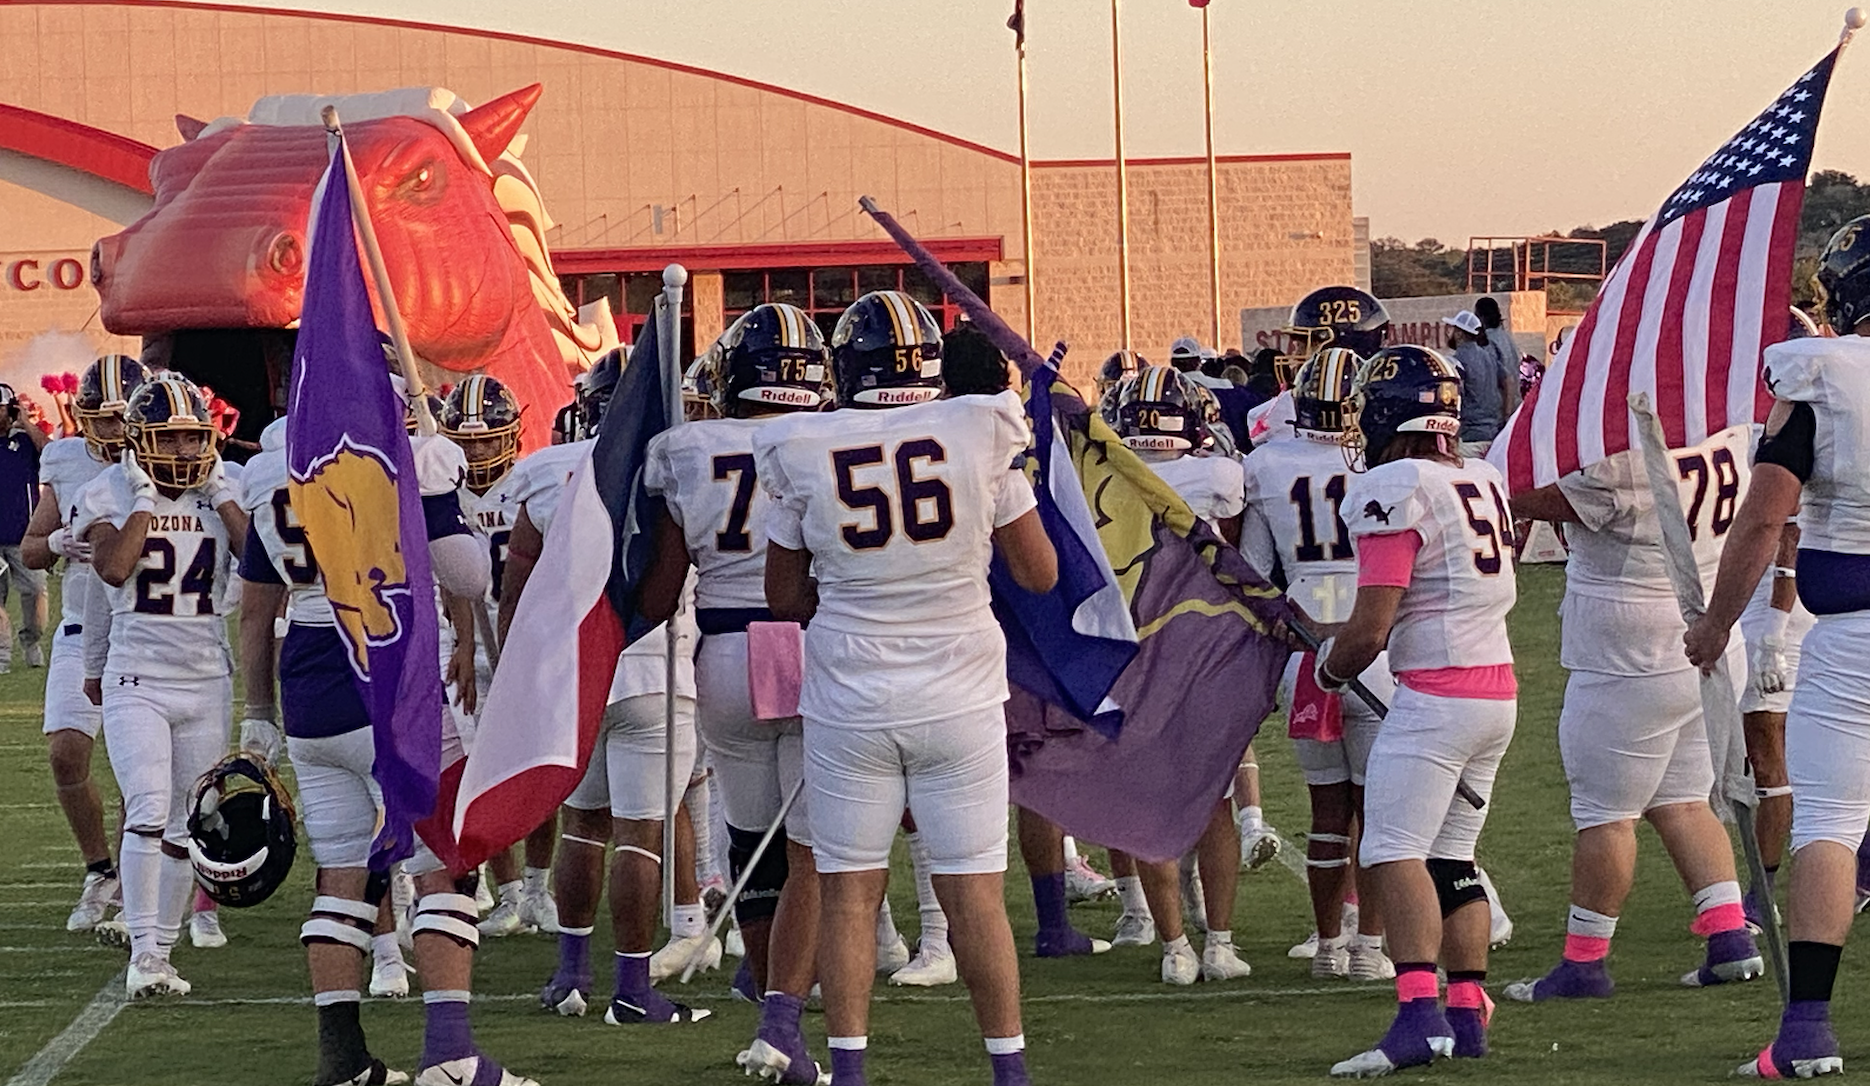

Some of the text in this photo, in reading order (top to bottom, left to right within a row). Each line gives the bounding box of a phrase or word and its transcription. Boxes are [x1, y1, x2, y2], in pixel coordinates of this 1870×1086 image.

[1319, 300, 1362, 325] 325
[780, 358, 806, 382] 75
[895, 347, 923, 373] 56
[1368, 356, 1402, 382] 25
[760, 389, 812, 405] Riddell
[878, 391, 932, 404] Riddell
[1138, 409, 1160, 429] 20
[1320, 410, 1337, 428] 11
[1129, 438, 1174, 449] Riddell
[829, 436, 954, 553] 56
[1673, 445, 1739, 542] 78
[151, 515, 205, 534] OZONA
[1289, 473, 1354, 562] 11
[134, 537, 216, 615] 24
